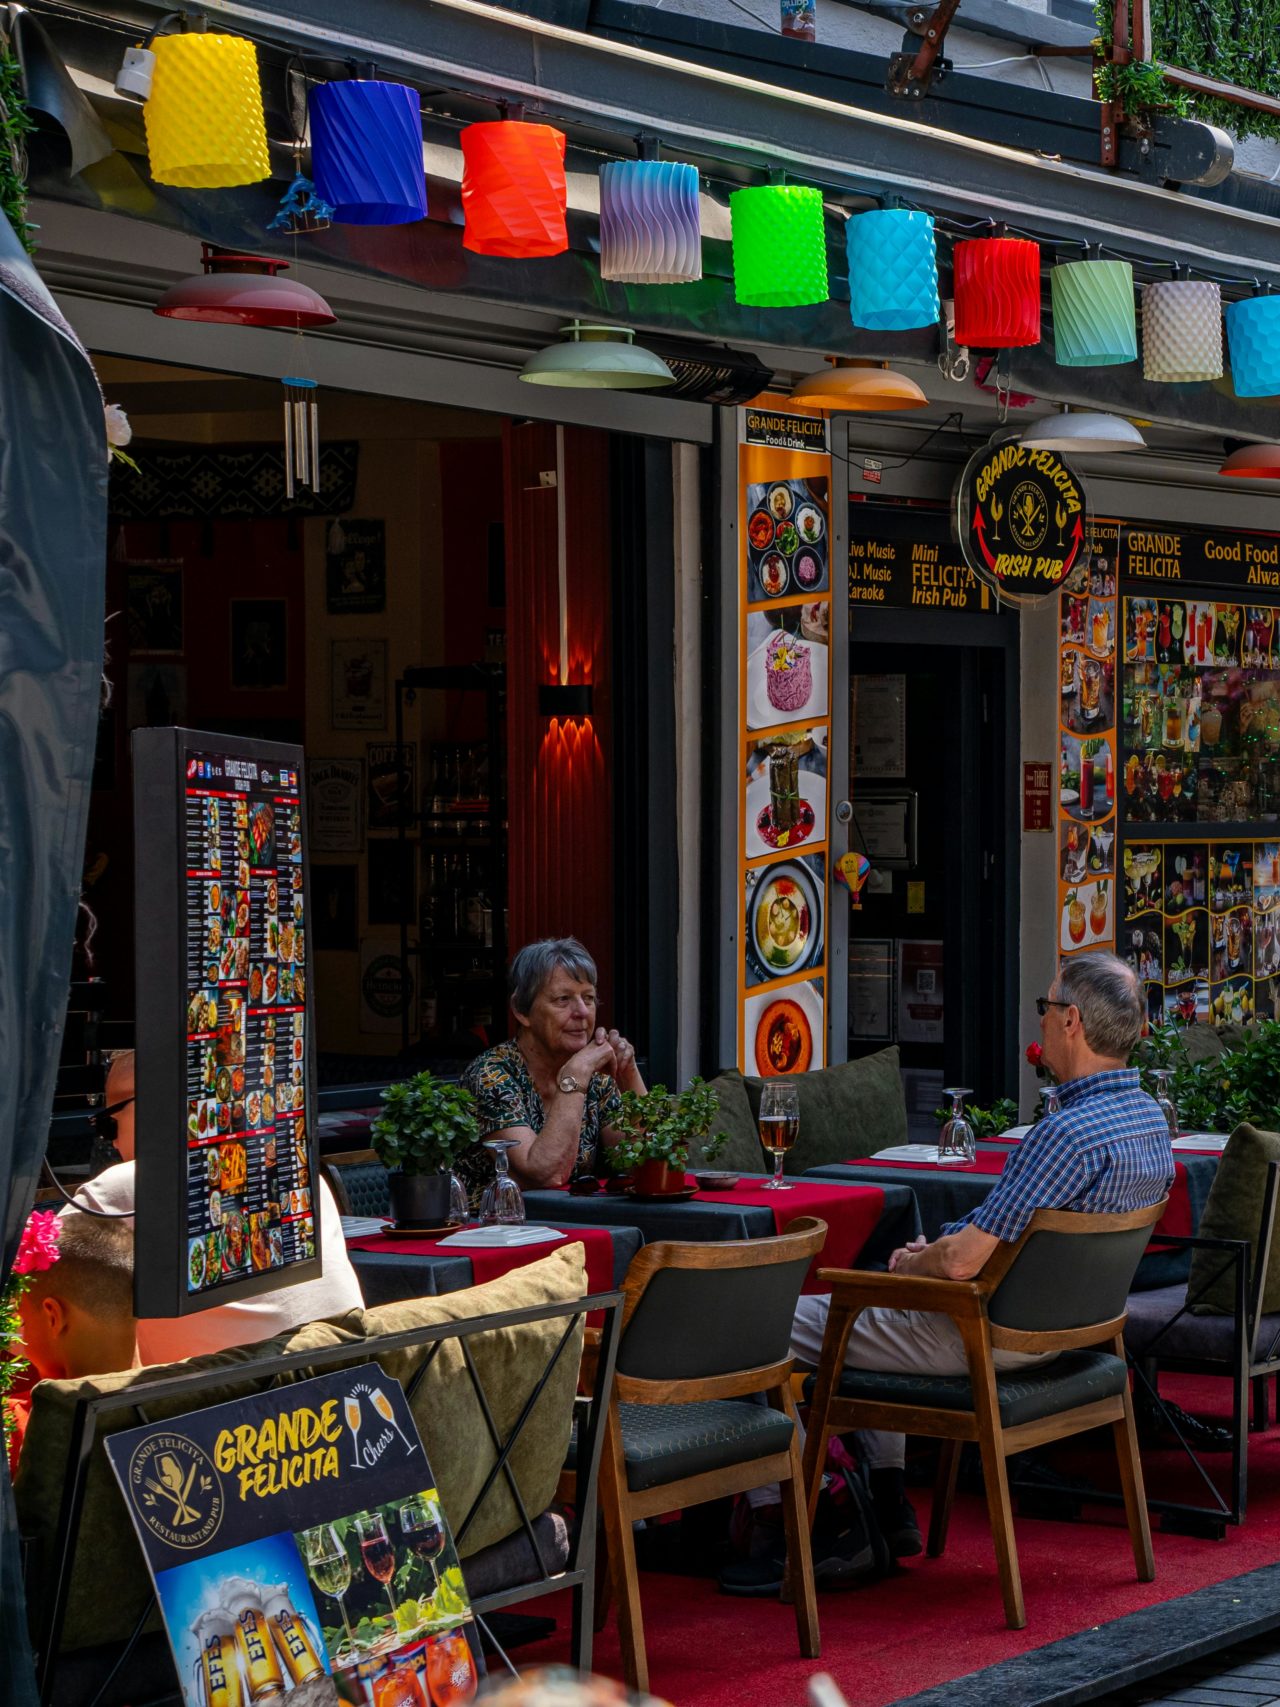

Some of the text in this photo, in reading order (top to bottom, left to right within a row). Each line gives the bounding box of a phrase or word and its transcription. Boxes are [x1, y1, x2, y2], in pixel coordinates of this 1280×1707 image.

[747, 415, 824, 436] GRANDE FELICITA
[976, 445, 1082, 514] GRANDE FELICITA
[1090, 527, 1118, 540] FELICITA
[1127, 531, 1182, 556] GRANDE
[867, 541, 896, 560] Music
[911, 544, 939, 562] Mini
[1204, 540, 1241, 562] Good
[1245, 543, 1279, 566] Food
[863, 562, 892, 582] Music
[911, 563, 977, 589] FELICITA
[993, 553, 1064, 580] IRISH PUB
[1127, 554, 1182, 579] FELICITA
[911, 586, 967, 608] Irish Pub
[214, 1399, 344, 1474] GRANDE
[362, 1428, 395, 1467] Cheers
[133, 1438, 206, 1485] GRANDE FELICITA
[236, 1446, 340, 1502] FELICITA
[148, 1497, 220, 1544] RESTAURANT AND PUB
[238, 1609, 267, 1664] EFES
[274, 1608, 307, 1659] EFES
[205, 1634, 227, 1692] EFES
